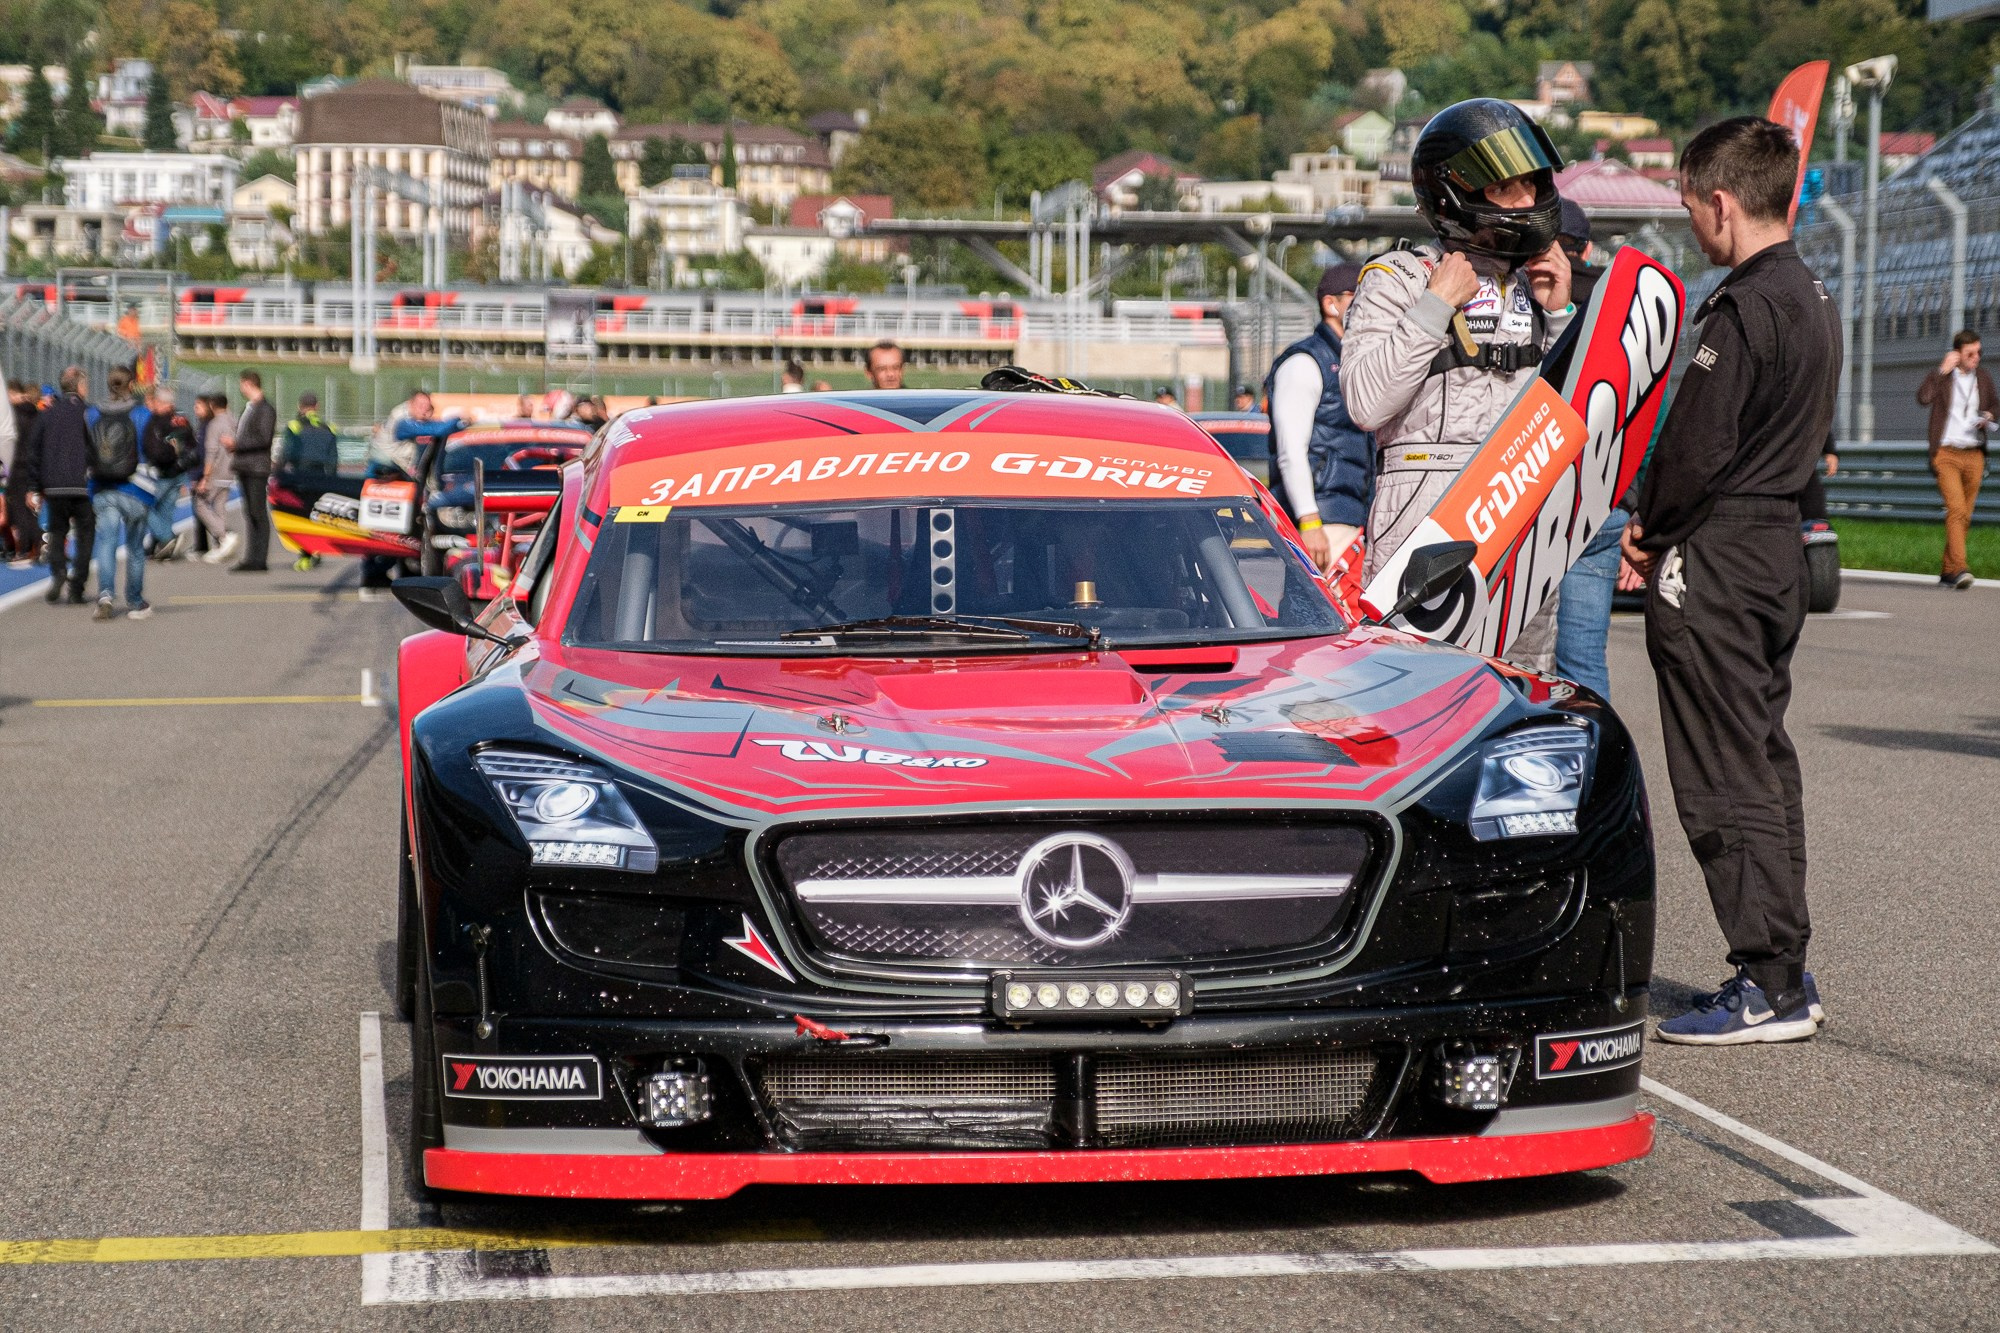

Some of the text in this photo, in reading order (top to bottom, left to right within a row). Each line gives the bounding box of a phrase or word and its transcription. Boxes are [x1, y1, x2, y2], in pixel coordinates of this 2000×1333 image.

[1500, 402, 1550, 465] ТОПЛИВО
[640, 450, 971, 506] ЗАПРАВЛЕНО
[1099, 456, 1213, 478] ТОПЛИВО
[1579, 1032, 1641, 1064] YOKOHAMA
[476, 1066, 586, 1090] YOKOHAMA
[652, 1074, 681, 1082] AURORA
[655, 1120, 685, 1128] AURORA
